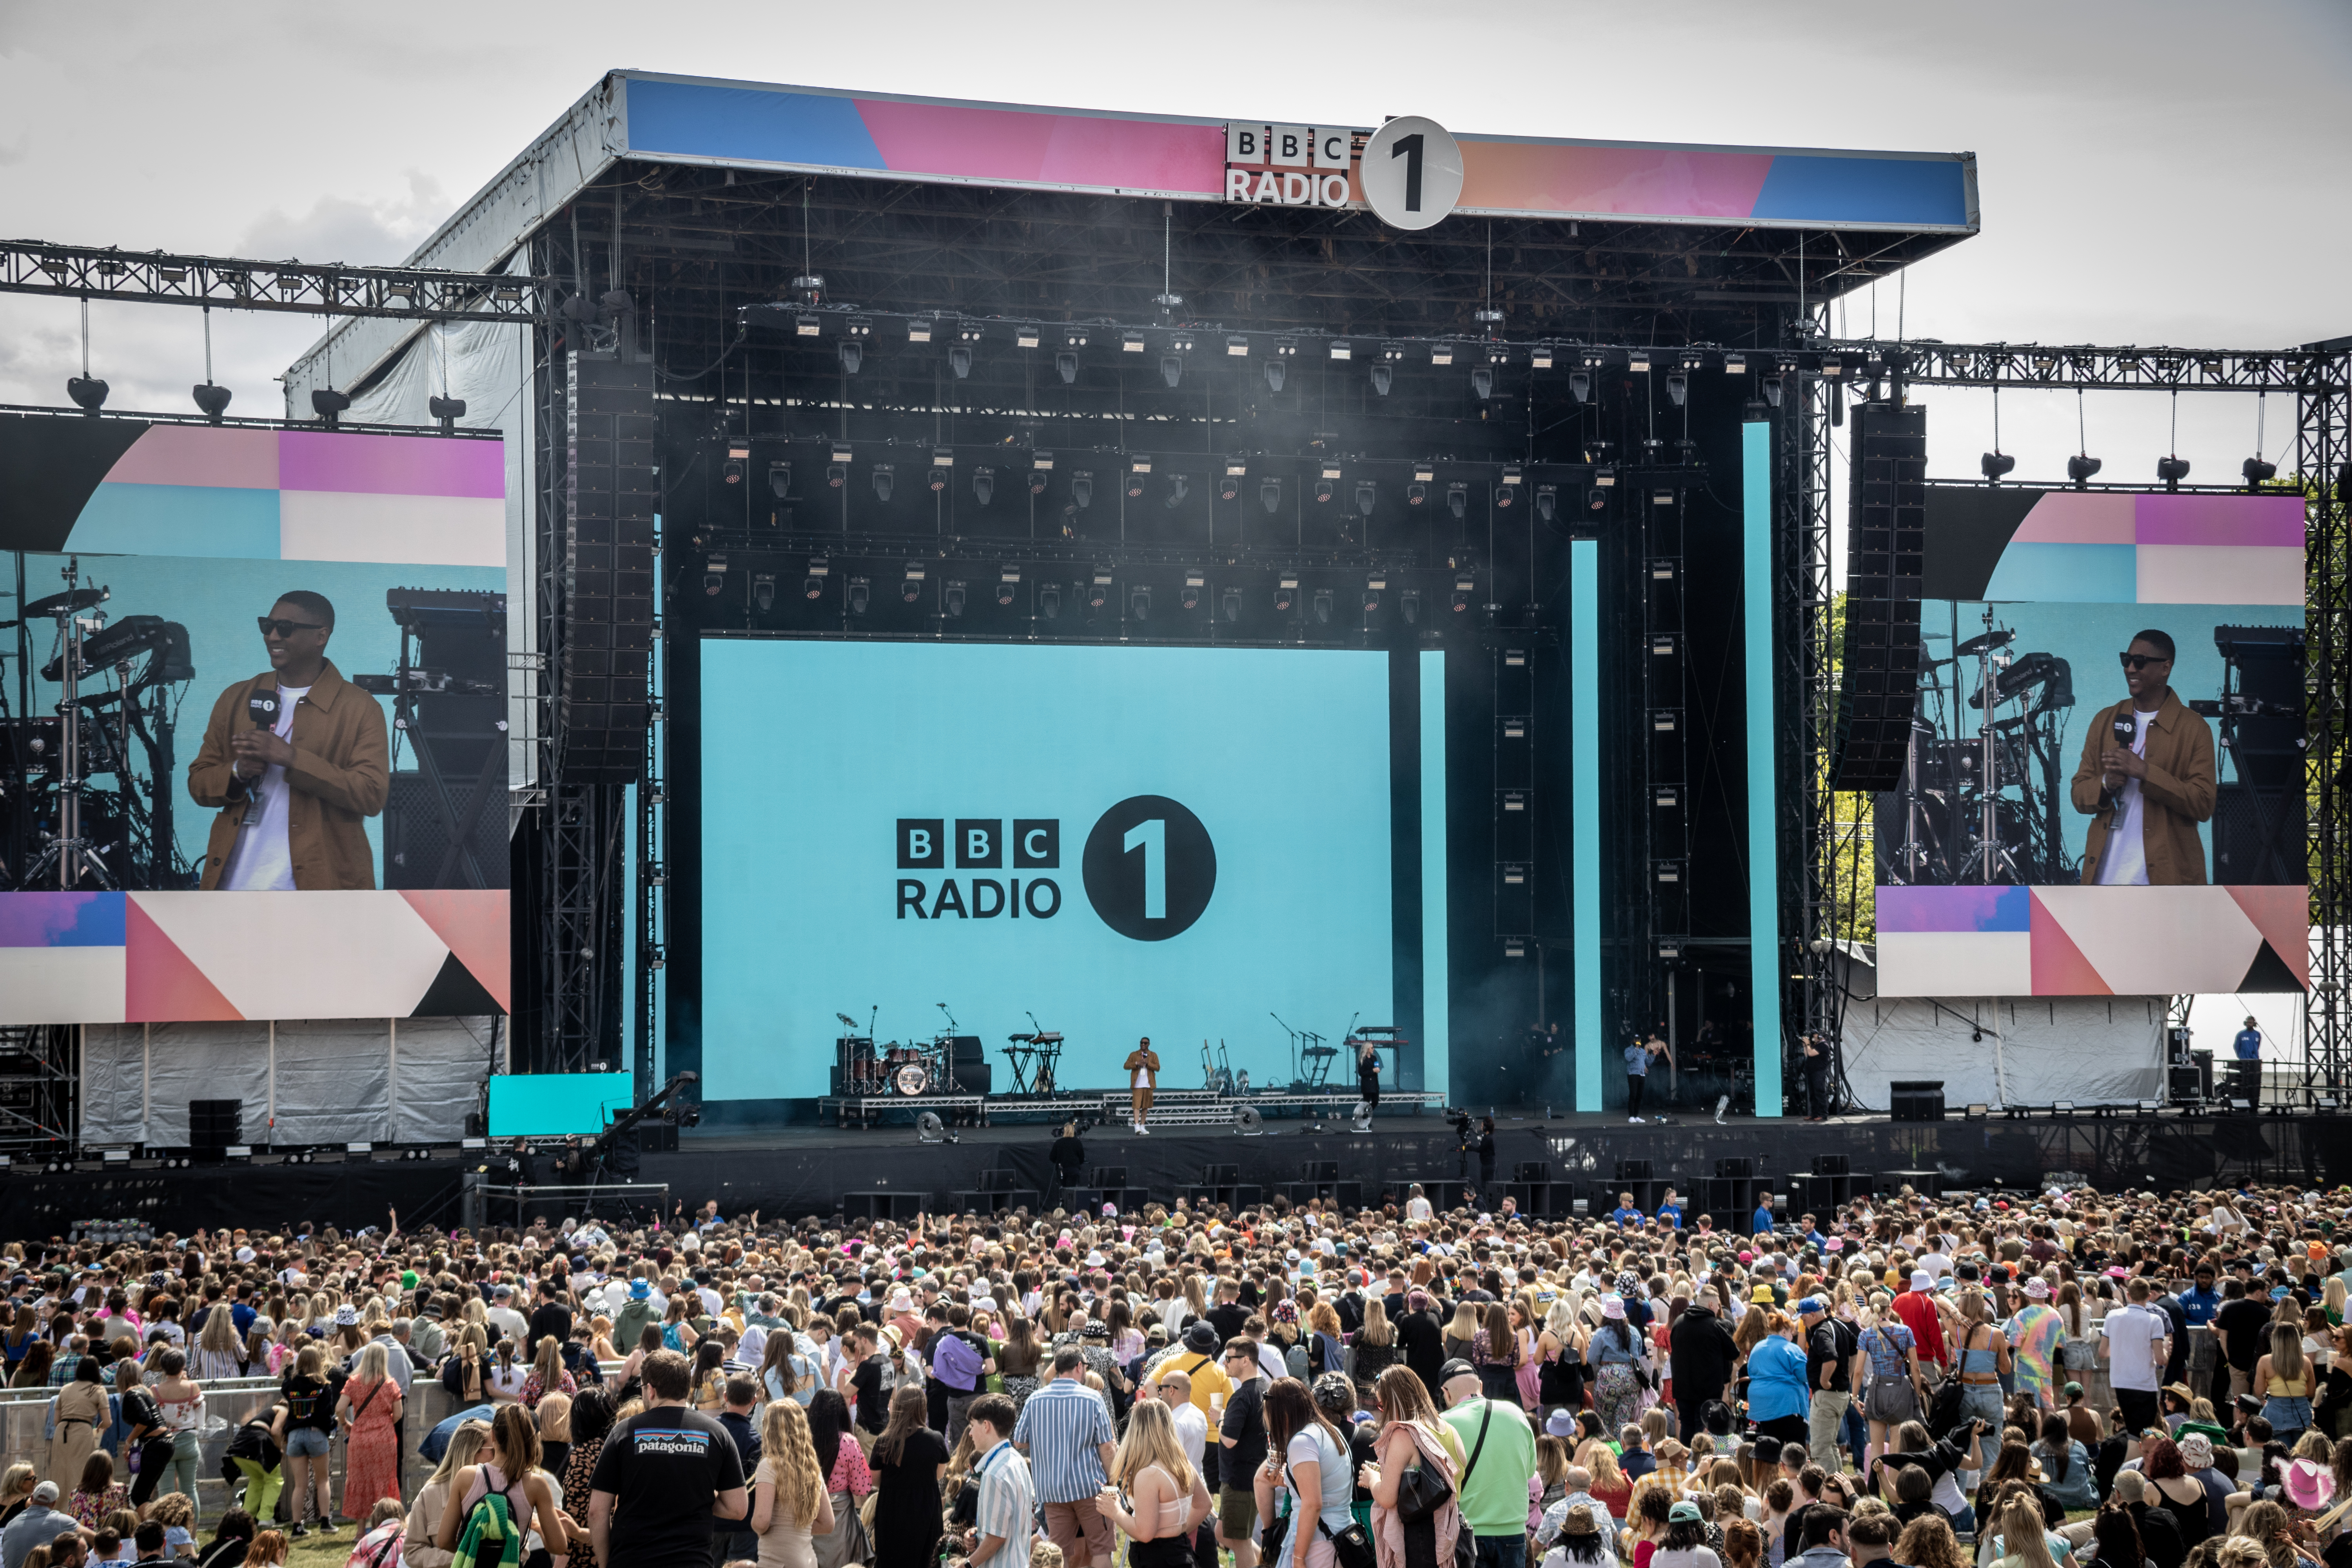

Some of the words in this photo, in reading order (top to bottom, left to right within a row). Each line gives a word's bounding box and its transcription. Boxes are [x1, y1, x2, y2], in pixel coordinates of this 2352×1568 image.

[1238, 131, 1342, 161] BBC
[1227, 169, 1350, 207] RADIO
[1391, 134, 1424, 212] 1
[909, 828, 1048, 859] BBC
[1123, 819, 1166, 919] 1
[896, 878, 1062, 920] RADIO
[639, 1441, 704, 1454] patagonia
